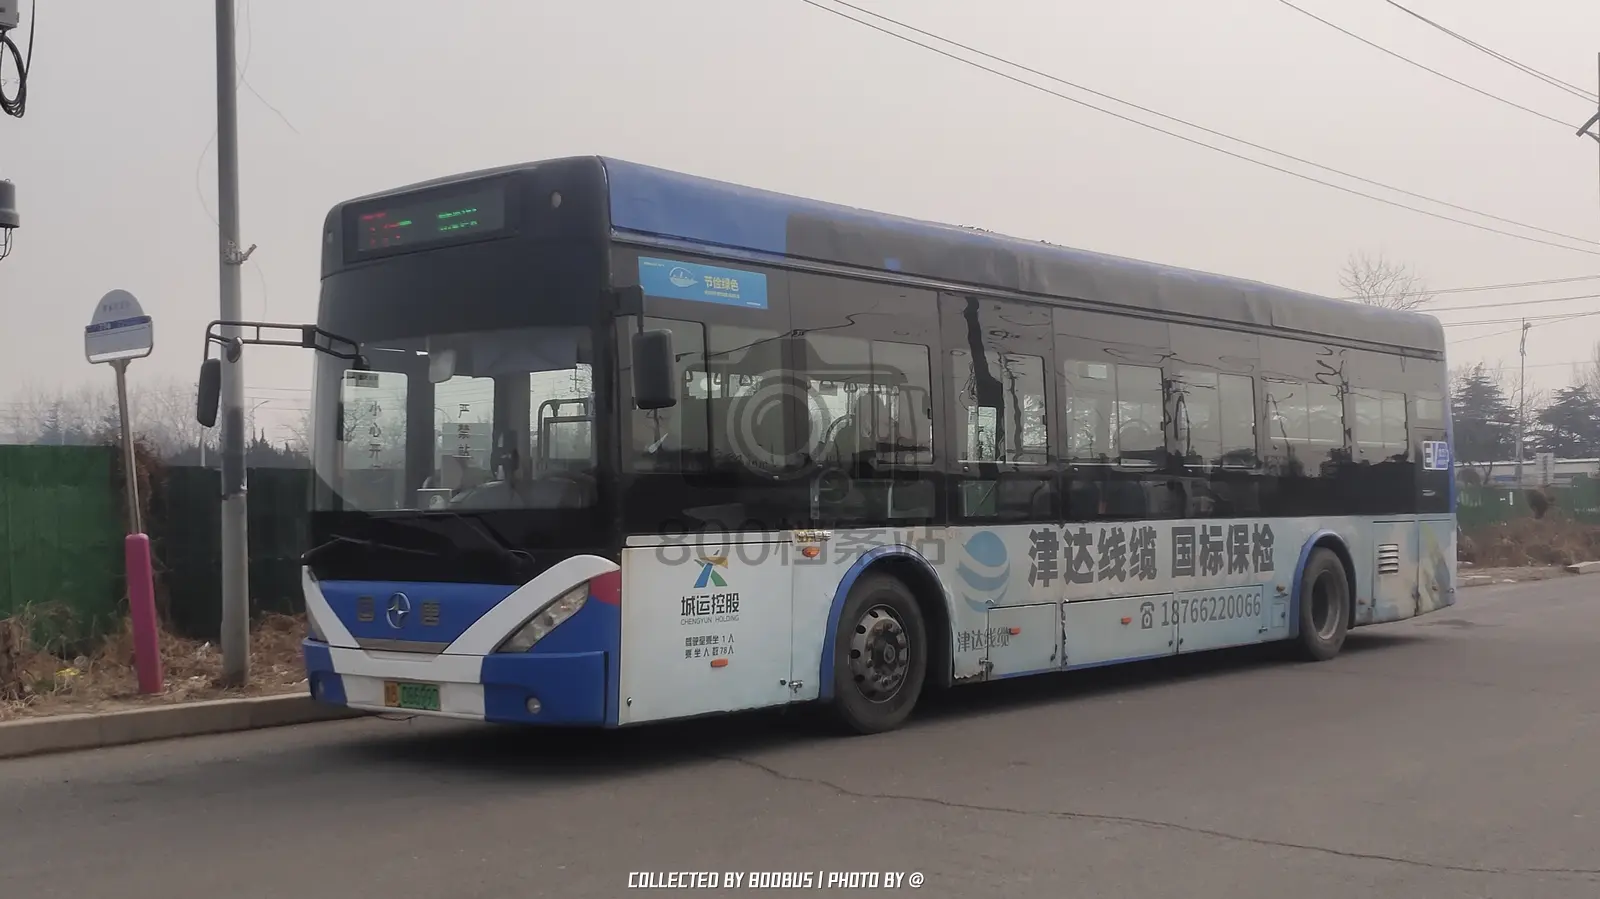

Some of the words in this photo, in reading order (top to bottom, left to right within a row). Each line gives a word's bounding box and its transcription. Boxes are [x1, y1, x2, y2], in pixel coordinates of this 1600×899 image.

[368, 401, 382, 468] 小心开
[1027, 525, 1158, 588] 津达线缆
[1170, 523, 1275, 579] 国标保检
[680, 592, 740, 617] 城运控股
[680, 617, 713, 626] CHENGYUN
[715, 614, 740, 623] HOLDING
[1161, 592, 1261, 627] 18766220066
[957, 626, 1010, 653] 津达线缆
